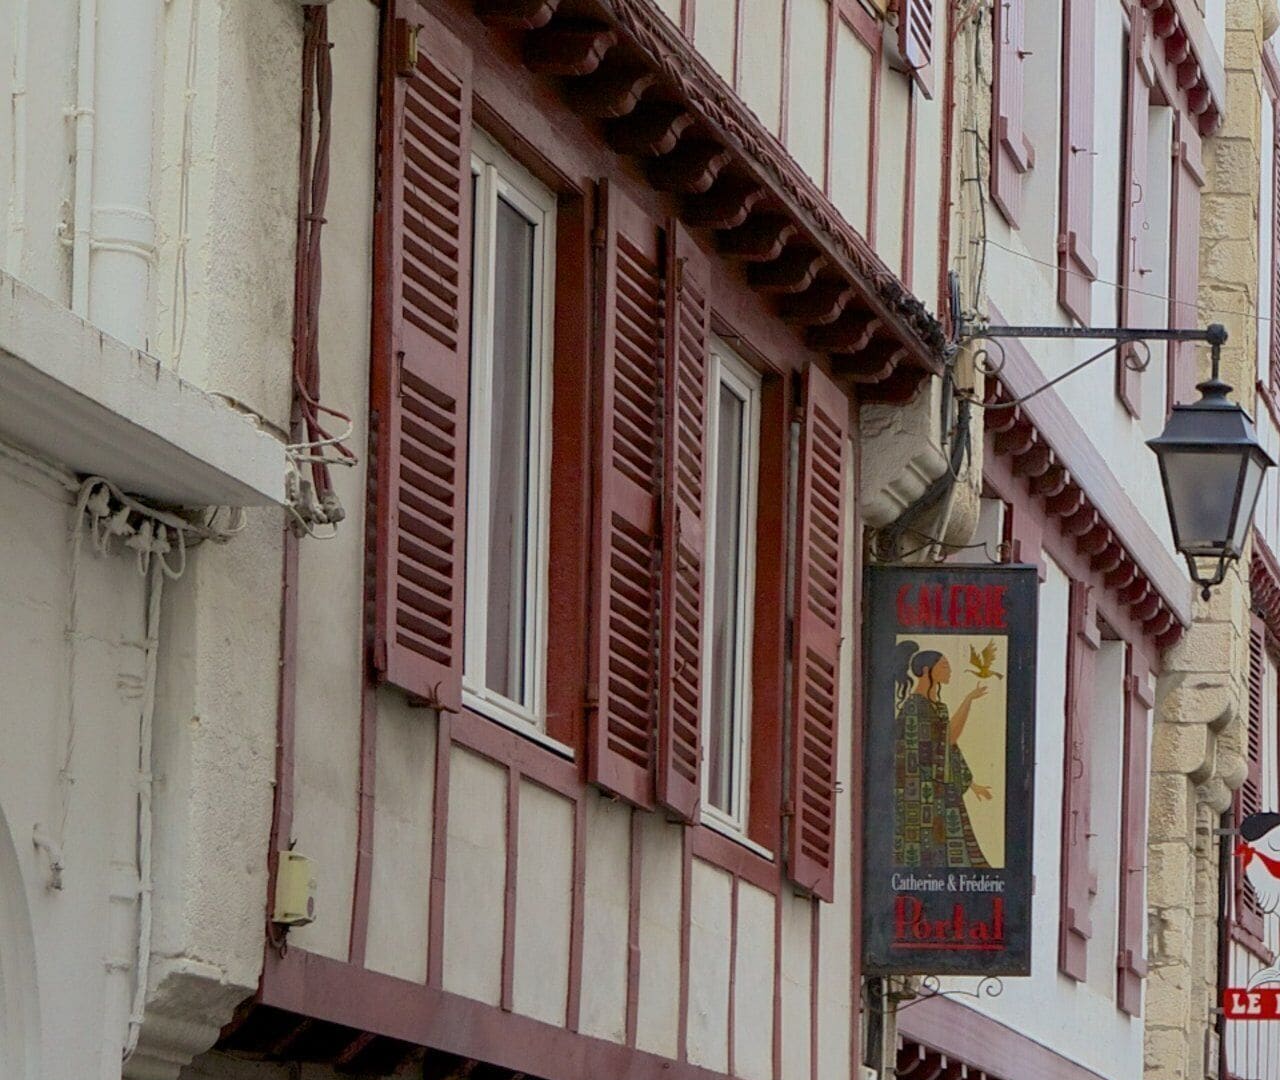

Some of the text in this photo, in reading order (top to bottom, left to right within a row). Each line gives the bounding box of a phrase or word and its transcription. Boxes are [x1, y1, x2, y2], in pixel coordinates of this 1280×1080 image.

[896, 583, 1008, 629] GALERIE
[891, 873, 1005, 892] Catherine & Frédéric
[892, 894, 1004, 940] Portal
[1231, 993, 1261, 1015] LE
